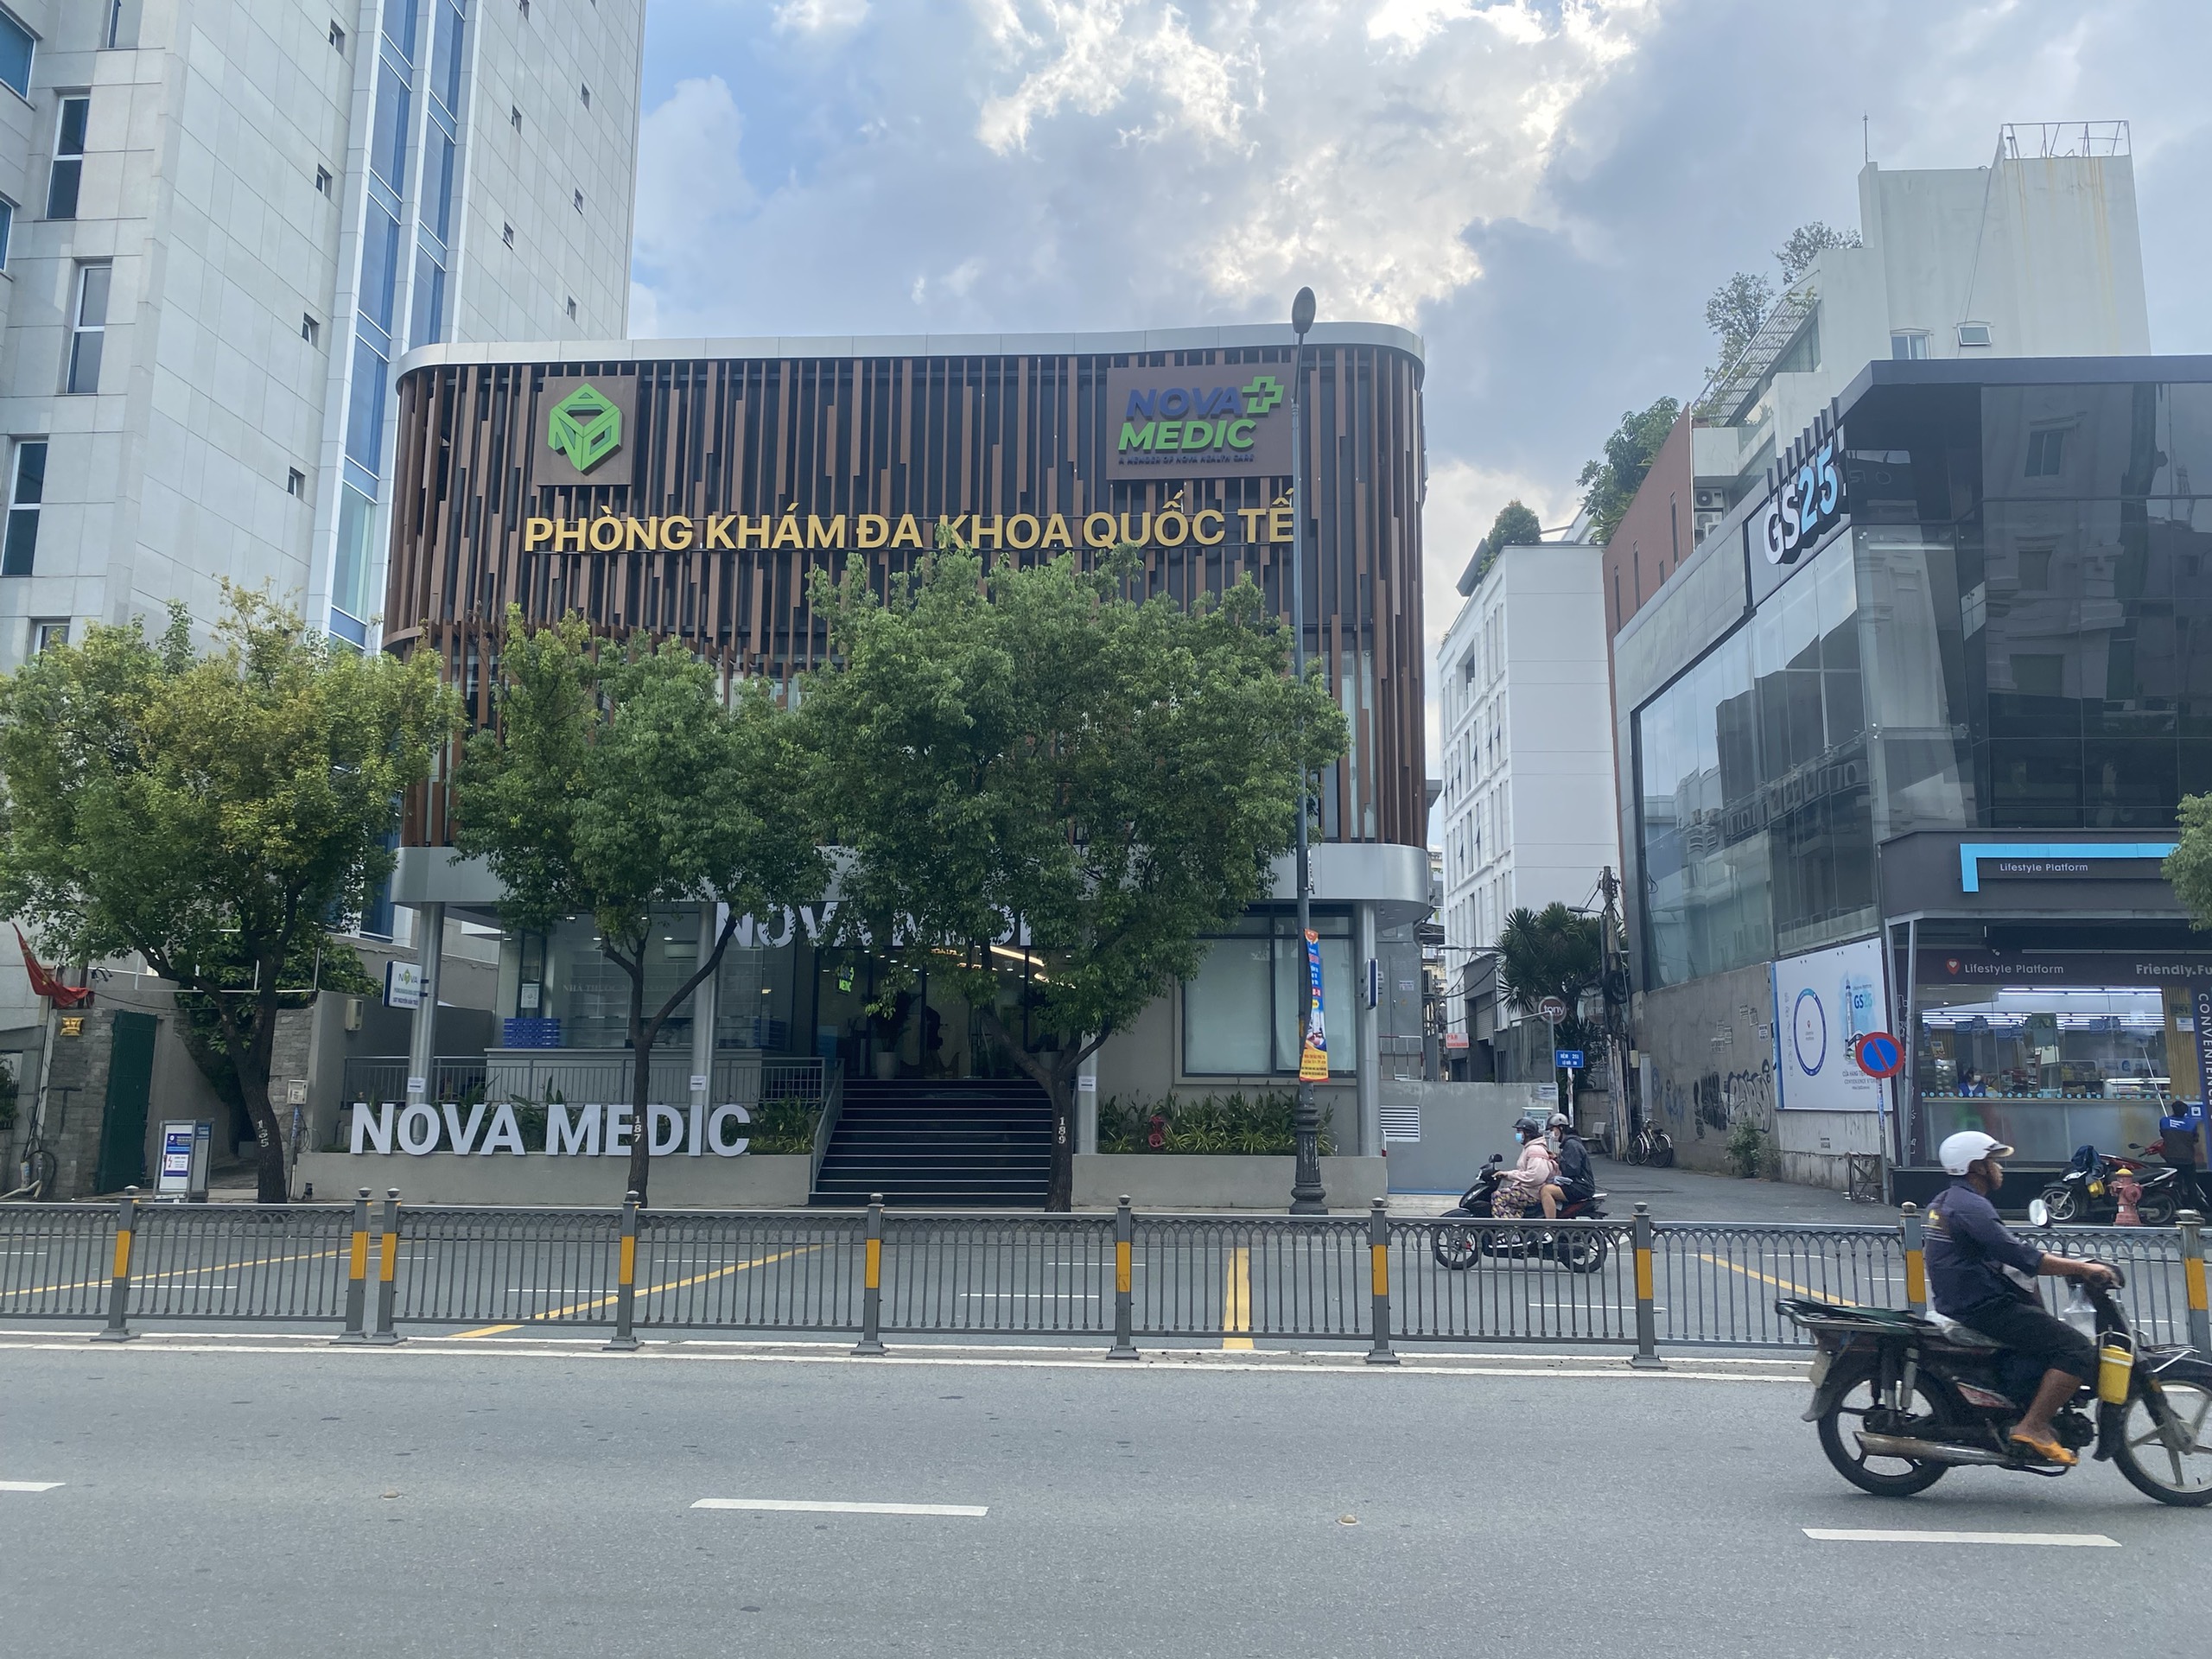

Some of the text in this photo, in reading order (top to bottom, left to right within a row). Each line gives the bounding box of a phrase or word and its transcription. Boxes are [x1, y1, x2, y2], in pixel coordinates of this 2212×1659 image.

[1126, 387, 1243, 418] NOVA
[1118, 419, 1256, 452] MEDIC
[1764, 442, 1838, 564] GS25
[524, 487, 1294, 552] PHÒNG KHÁM ĐA KHOA QUỐC TẾ
[1999, 863, 2088, 874] Lifestyle Platform
[1964, 963, 2012, 976] Lifestyle
[2016, 963, 2064, 975] Platform
[349, 1103, 751, 1157] NOVA MEDIC
[633, 1115, 642, 1143] 187
